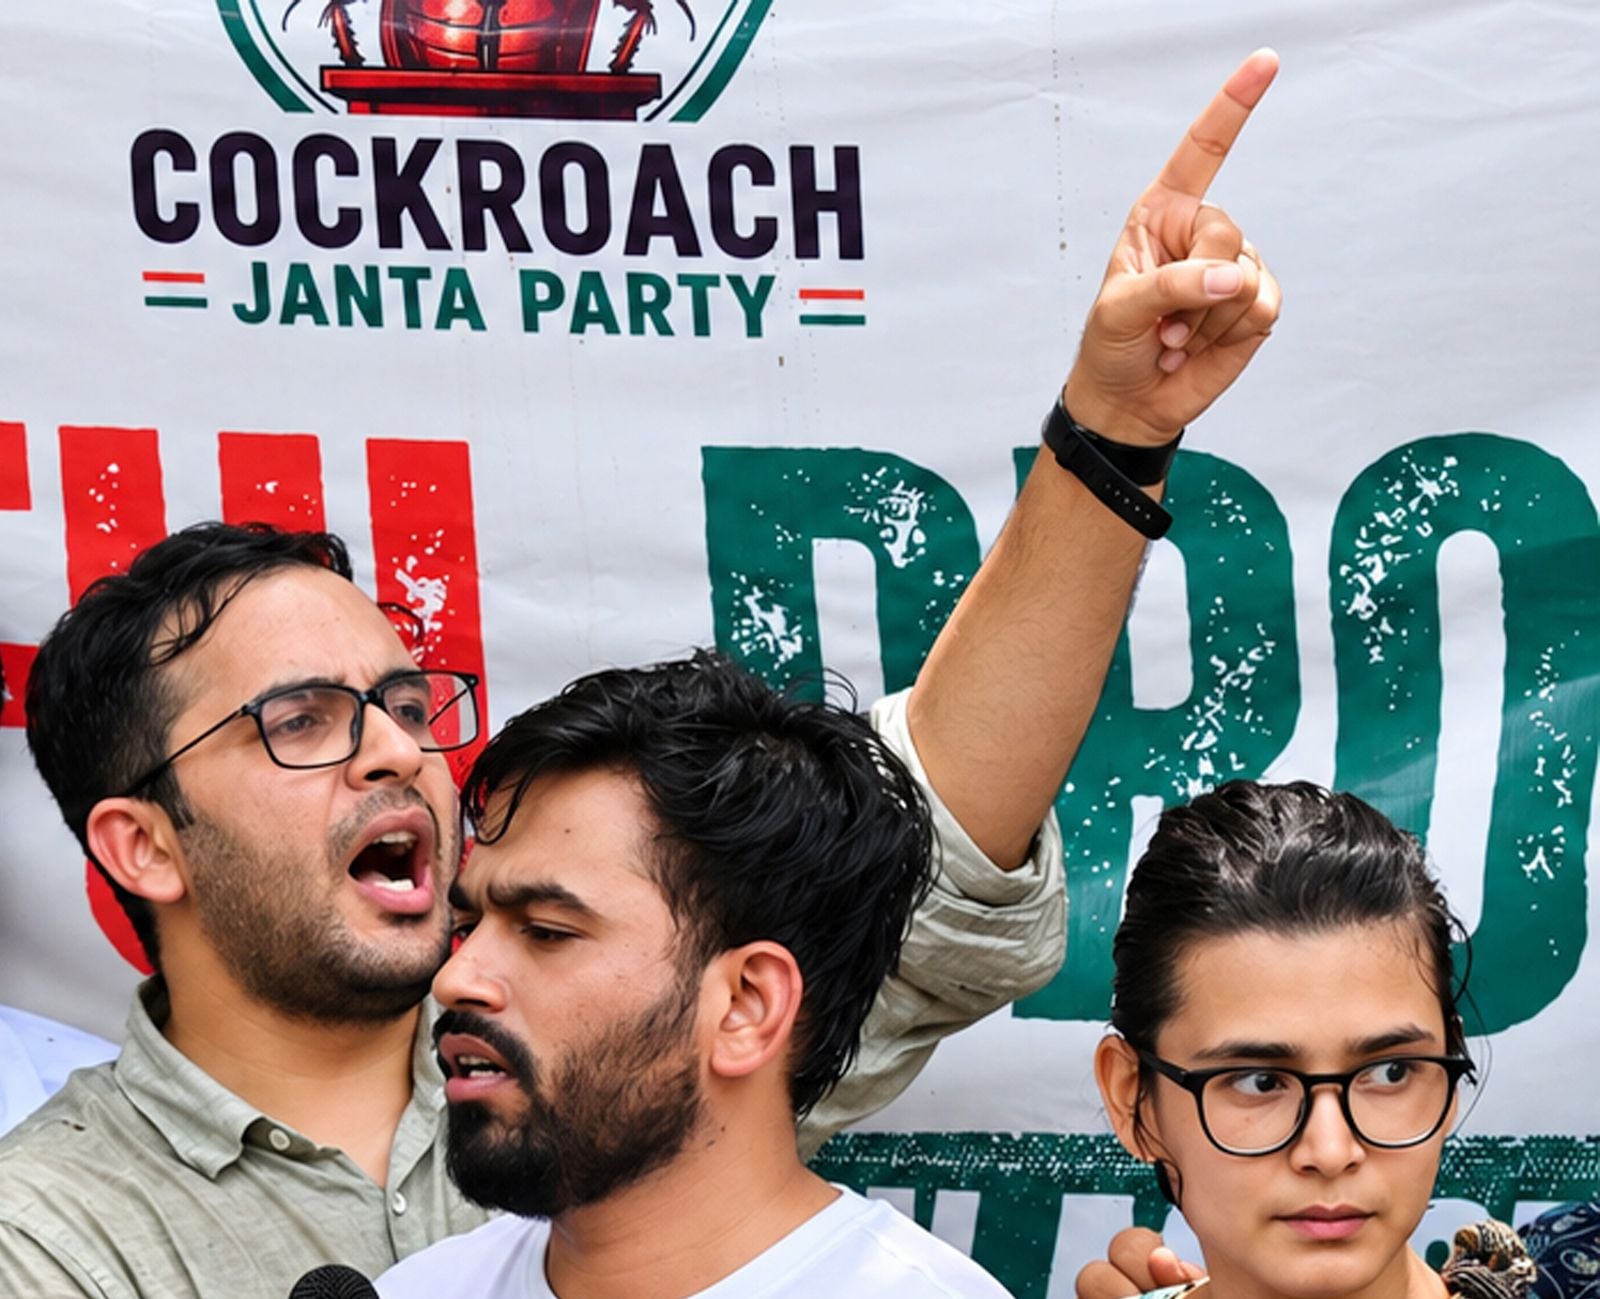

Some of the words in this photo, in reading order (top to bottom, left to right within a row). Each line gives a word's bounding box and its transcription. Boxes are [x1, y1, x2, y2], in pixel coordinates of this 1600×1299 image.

[130, 128, 865, 261] COCKROACH
[232, 261, 487, 331] JANTA
[519, 269, 775, 338] PARTY
